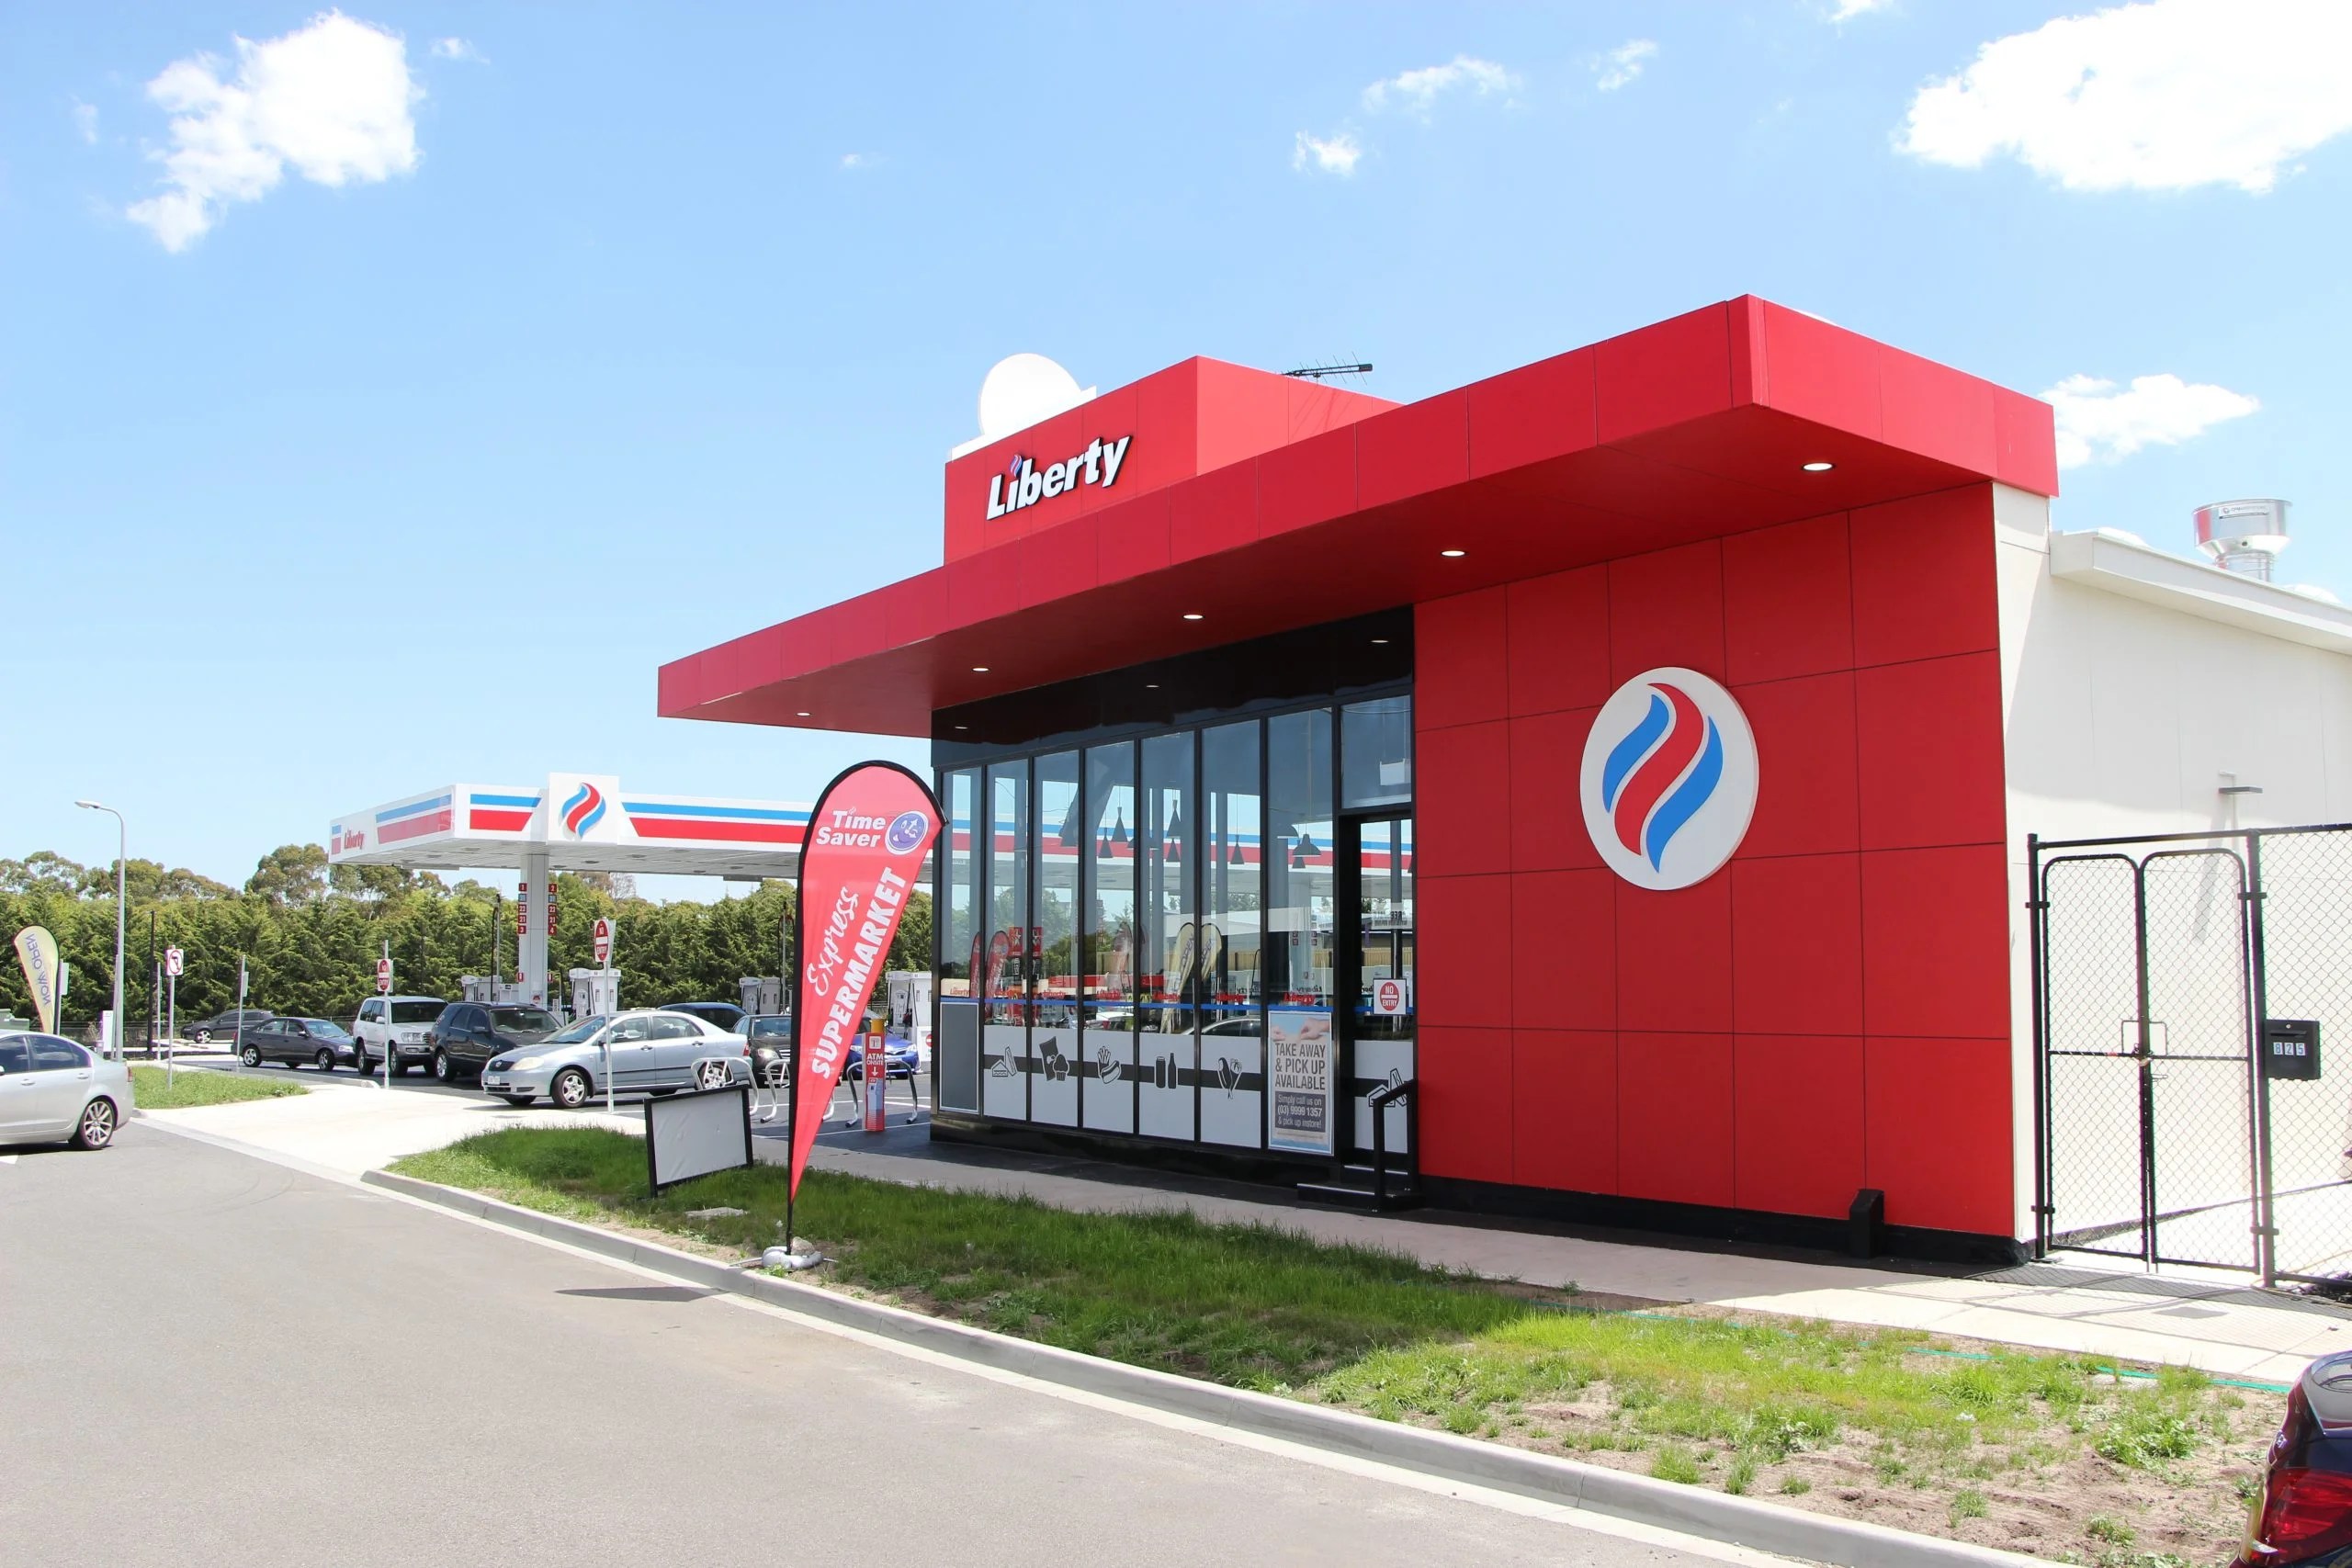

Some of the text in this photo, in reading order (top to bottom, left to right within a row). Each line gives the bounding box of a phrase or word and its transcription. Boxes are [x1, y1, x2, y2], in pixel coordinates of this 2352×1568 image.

[986, 435, 1132, 521] Liberty
[832, 807, 887, 830] Time
[816, 827, 881, 847] Saver
[807, 886, 859, 997] Express
[811, 866, 907, 1079] SUPERMARKET
[1385, 986, 1394, 994] NO
[1275, 1043, 1326, 1058] TAKE AWAY
[1275, 1058, 1326, 1075] & PICK UP
[1275, 1074, 1326, 1090] AVAILABLE
[1306, 1107, 1322, 1117] 1357
